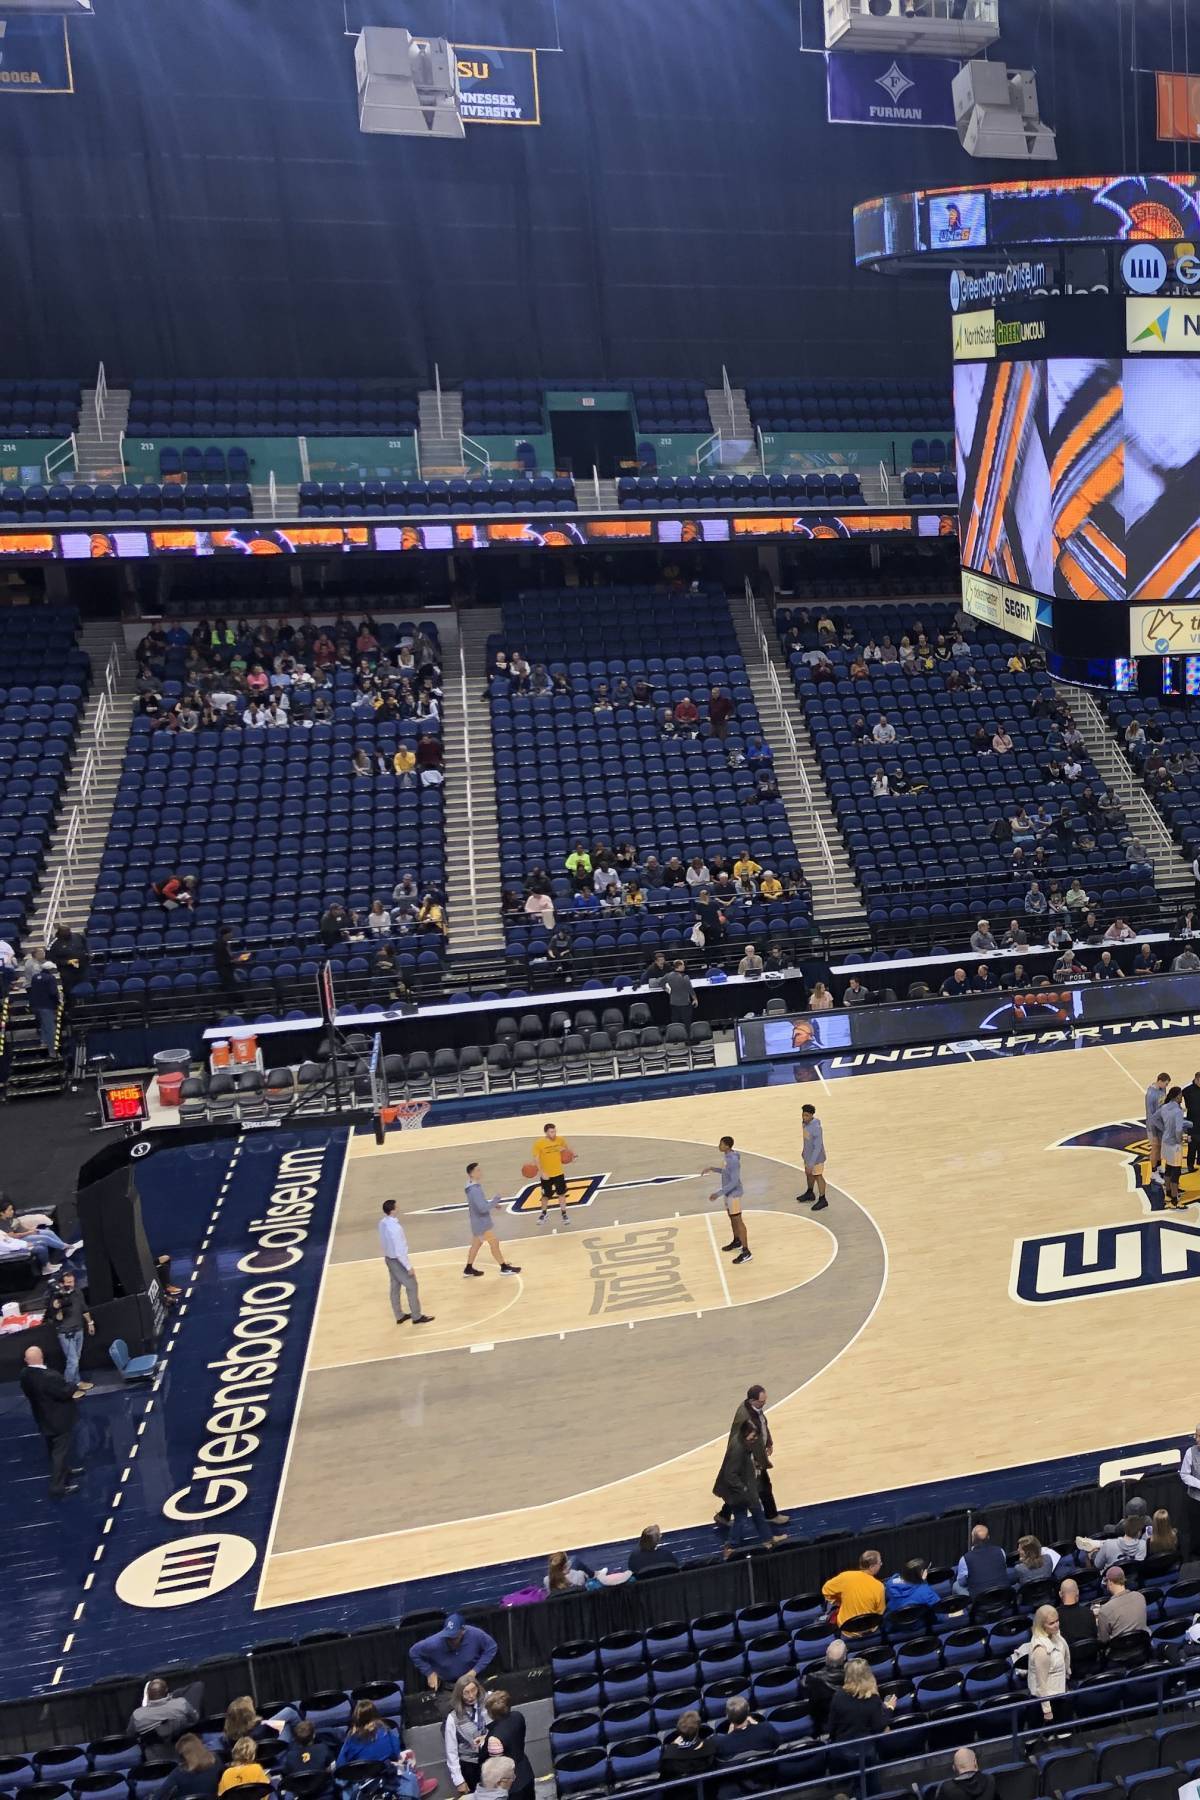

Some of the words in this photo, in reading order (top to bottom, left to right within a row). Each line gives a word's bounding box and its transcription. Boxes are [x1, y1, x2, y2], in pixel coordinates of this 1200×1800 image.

[869, 106, 922, 120] FURMAN
[960, 271, 1003, 302] Greensboro
[1005, 262, 1045, 292] Coliseum
[964, 322, 995, 346] NorthState
[996, 320, 1021, 346] GREEN
[1021, 320, 1045, 341] LINCOLN
[2, 443, 17, 453] 214
[140, 441, 154, 451] 213
[660, 438, 673, 447] 212
[1004, 597, 1033, 623] SEGRA
[109, 1086, 140, 1100] 14:06
[113, 1099, 138, 1117] 30
[241, 1118, 282, 1130] SPALDING
[236, 1146, 327, 1274] Coliseum
[162, 1281, 297, 1521] Greensboro
[527, 1670, 543, 1678] 124
